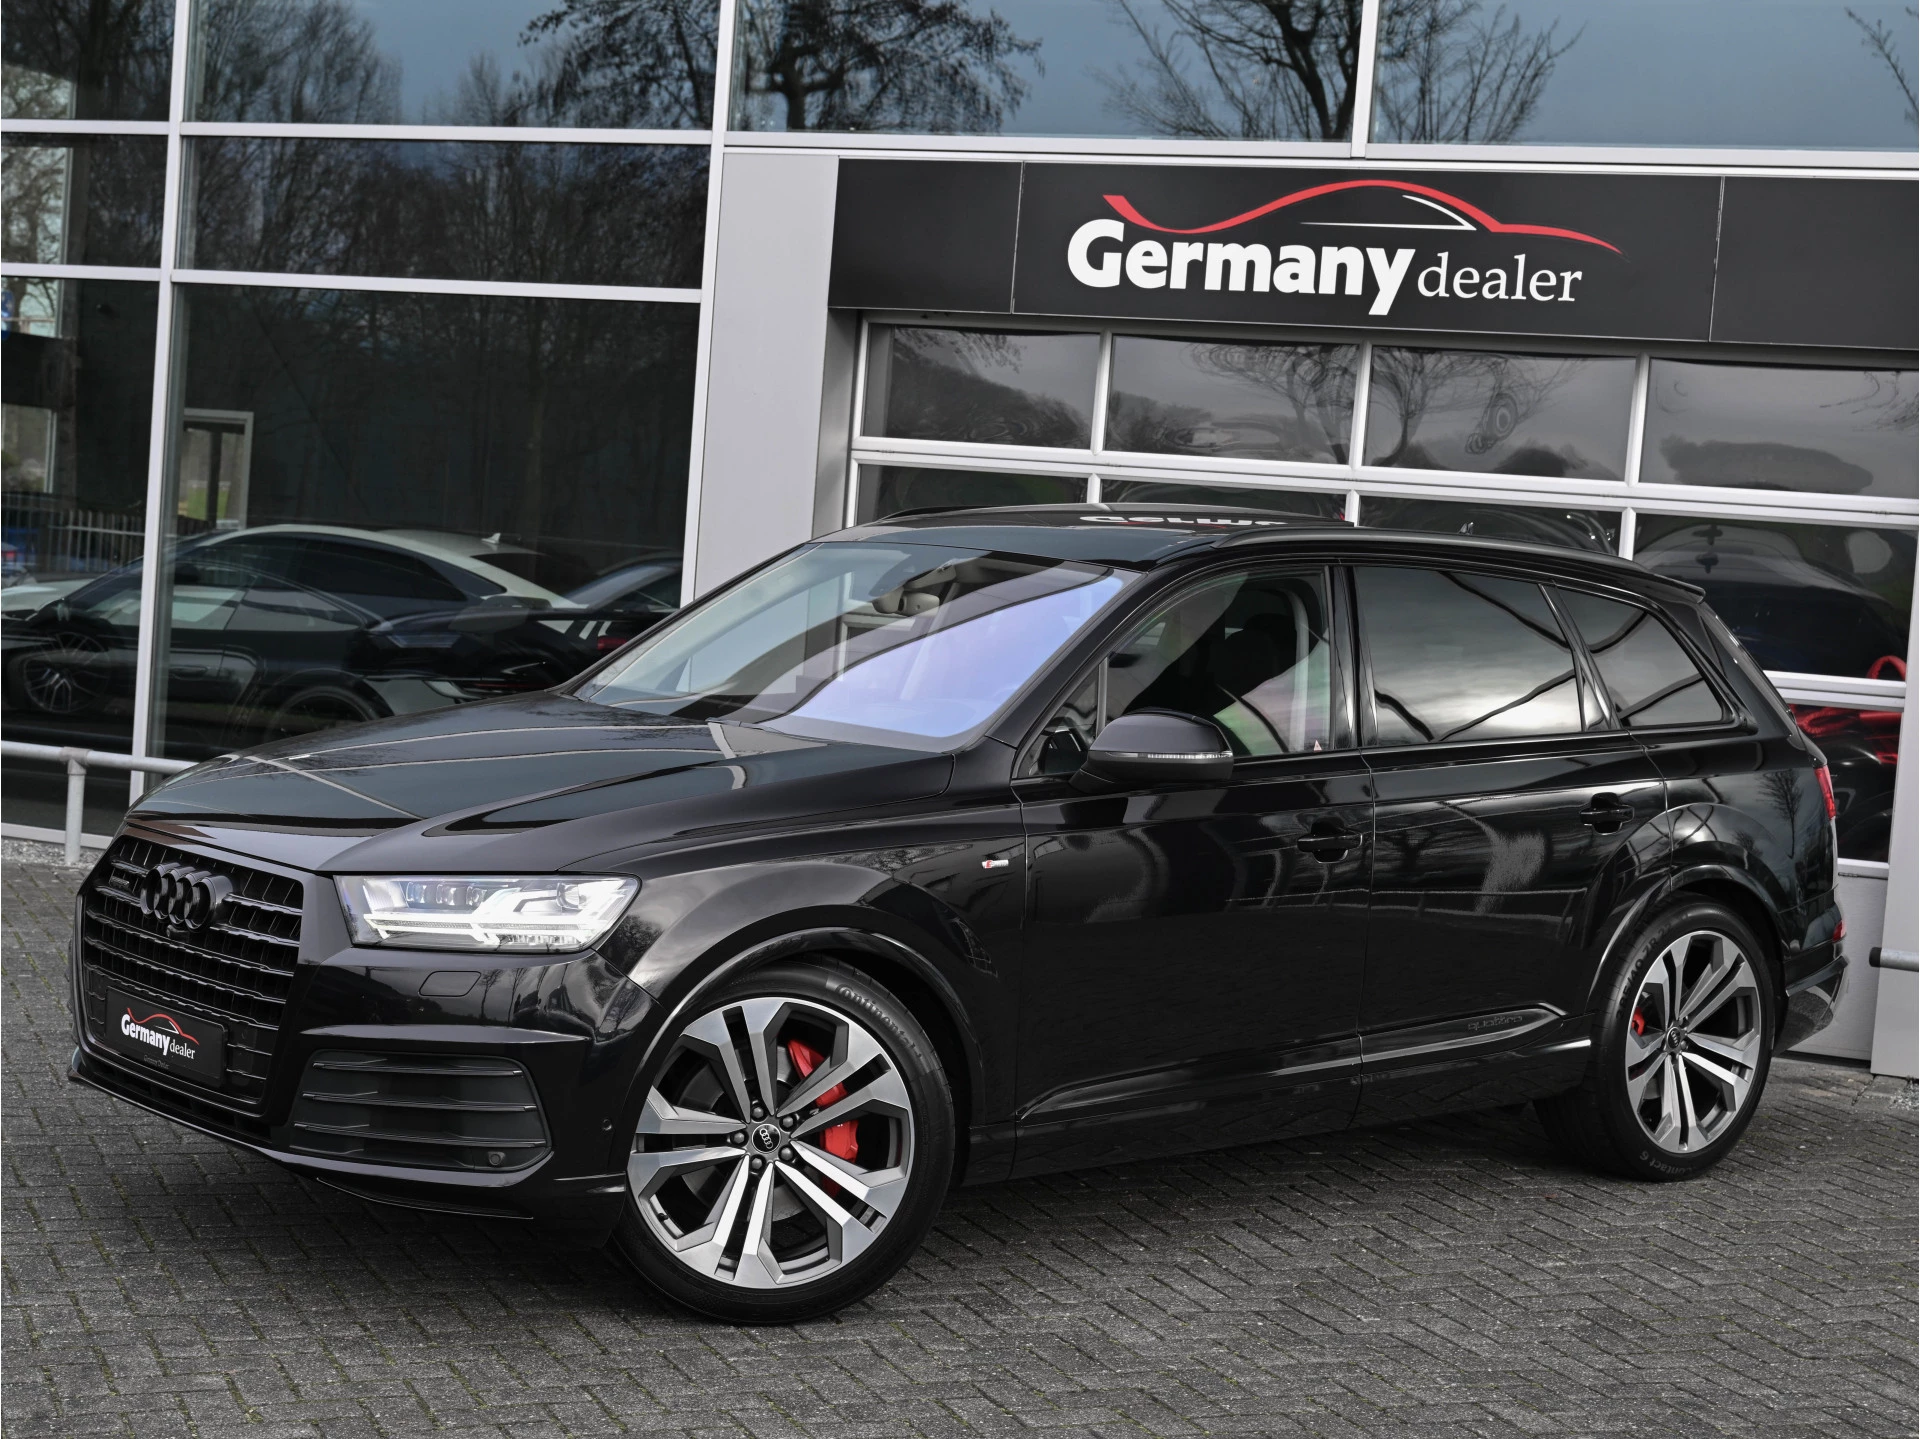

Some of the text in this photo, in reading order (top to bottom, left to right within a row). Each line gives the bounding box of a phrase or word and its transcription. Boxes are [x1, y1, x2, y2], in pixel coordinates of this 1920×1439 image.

[1067, 218, 1582, 316] Germany dealer
[121, 1013, 196, 1060] Germany dealer
[835, 983, 922, 1059] Continental
[1467, 1014, 1523, 1031] quattro
